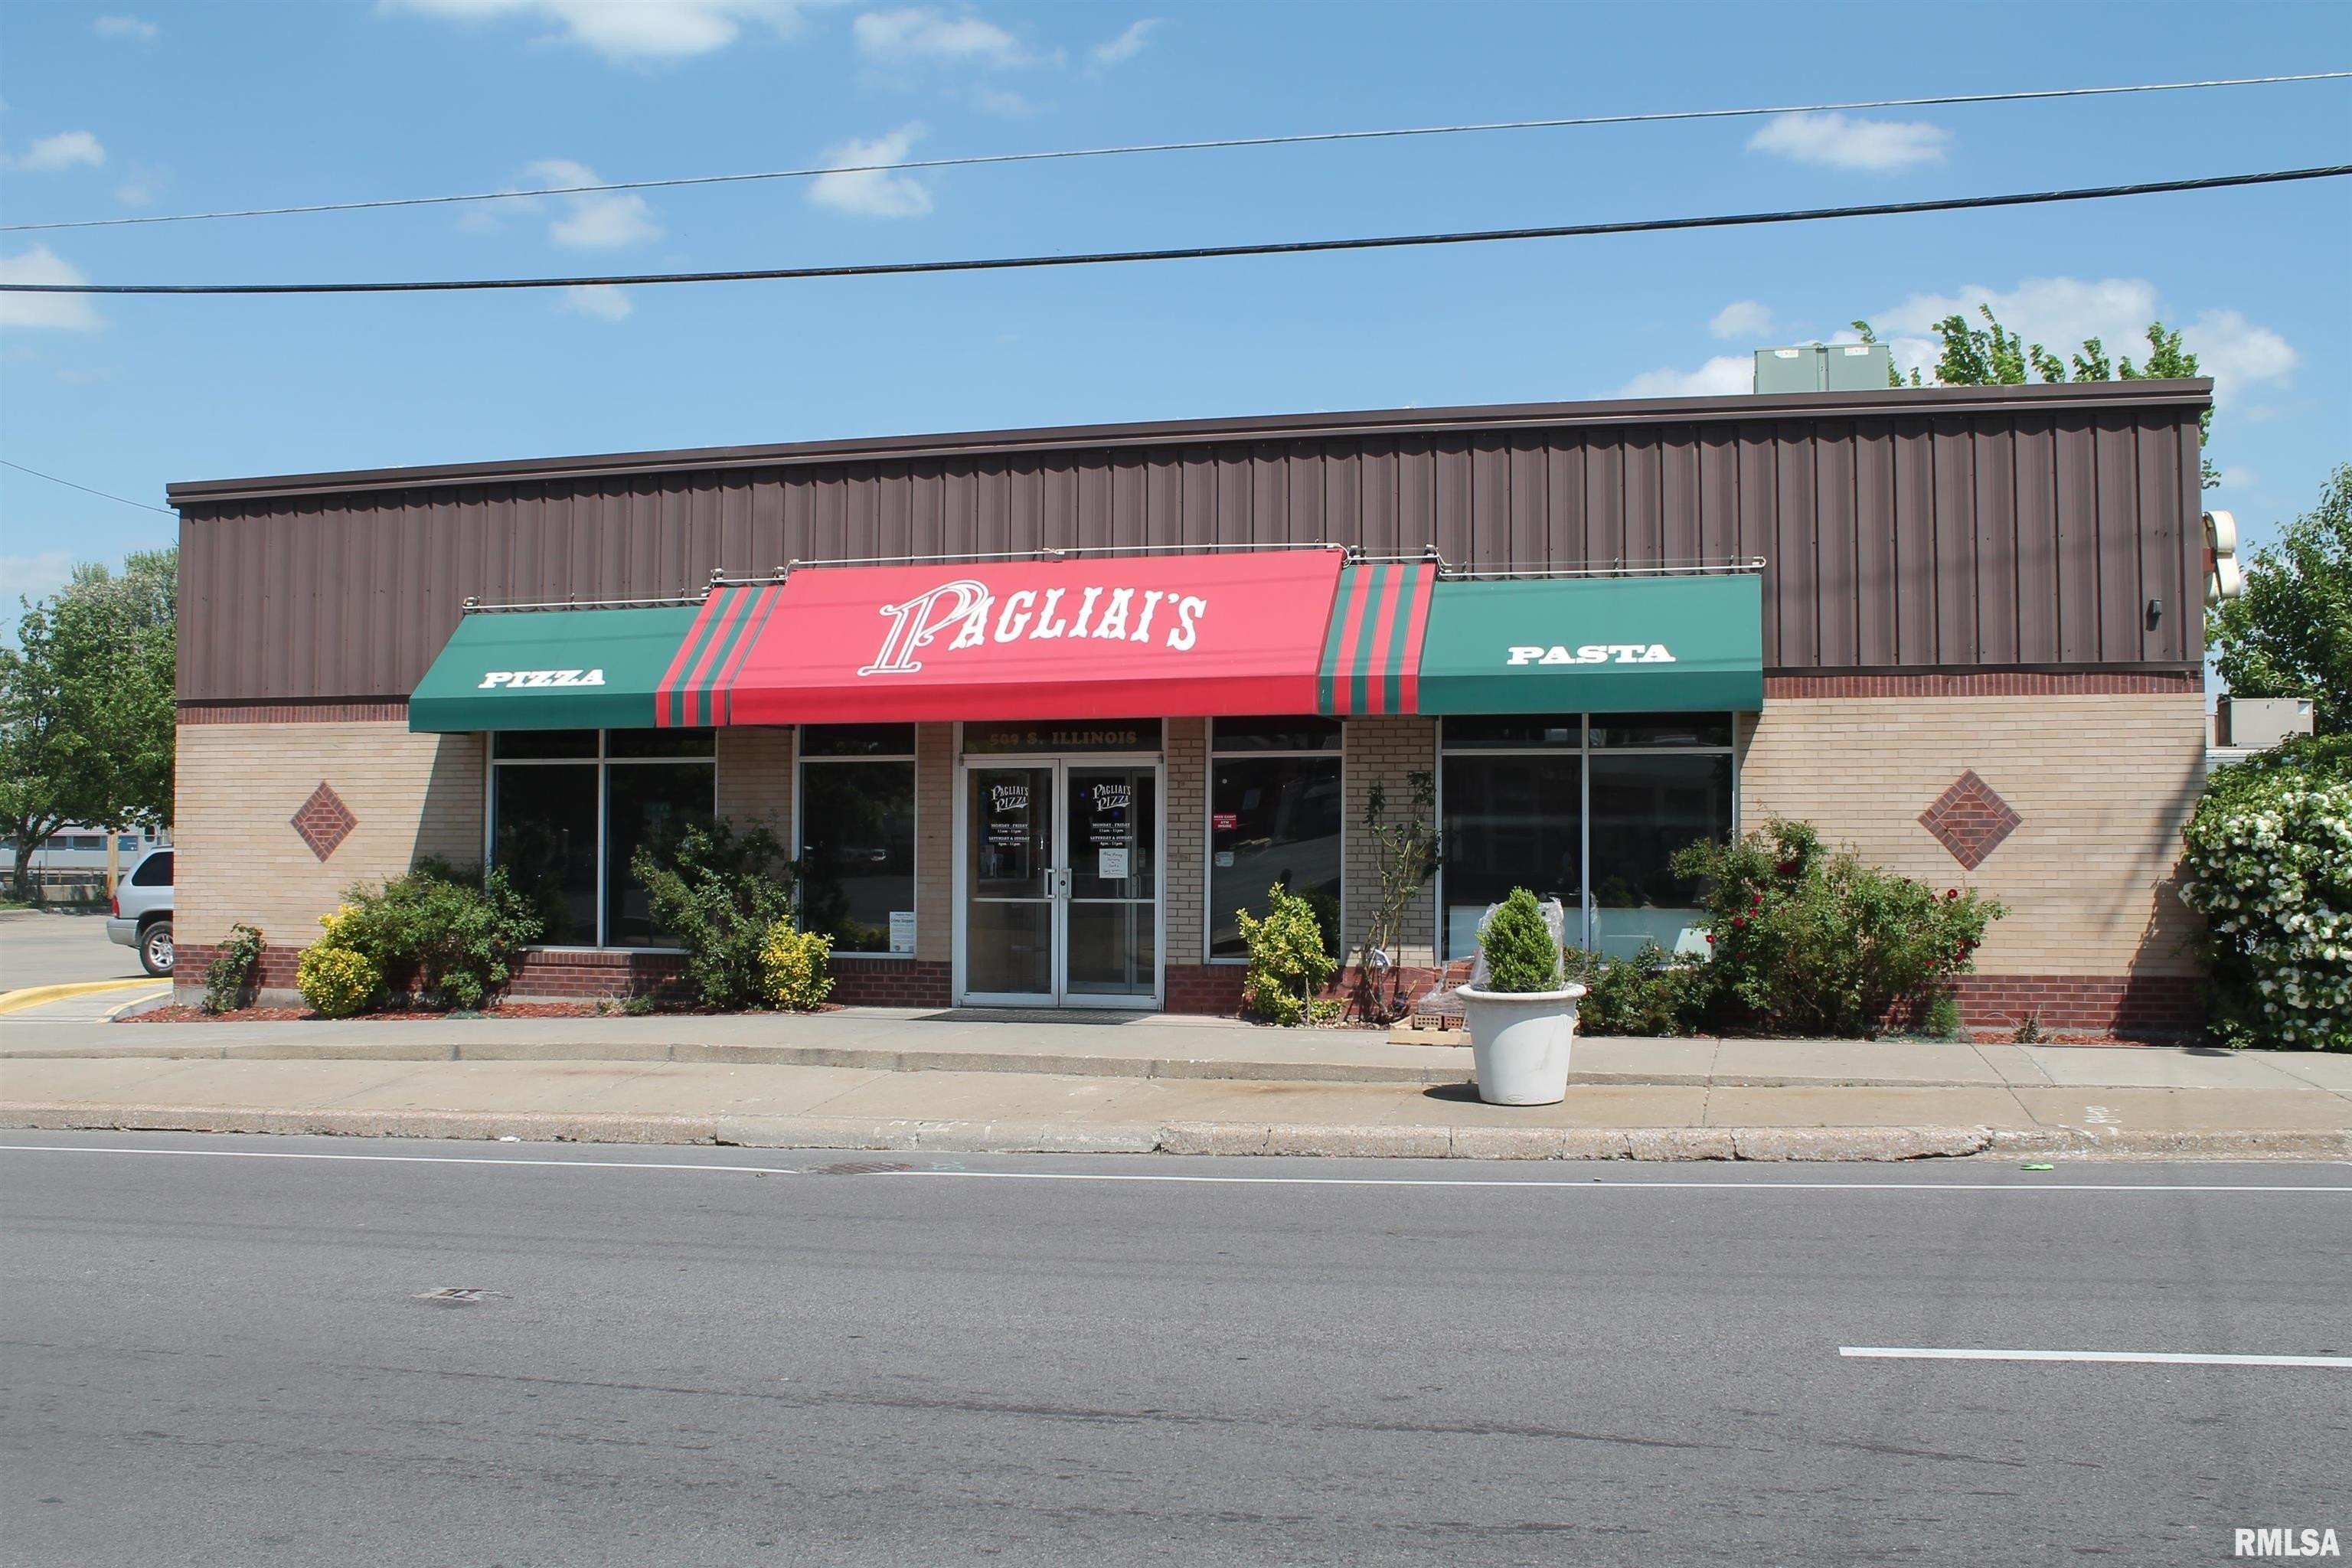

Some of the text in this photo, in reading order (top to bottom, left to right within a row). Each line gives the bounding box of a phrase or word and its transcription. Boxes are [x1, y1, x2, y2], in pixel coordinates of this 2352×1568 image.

[857, 580, 1207, 676] PAGLIAI'S
[1507, 644, 1676, 665] PASTA
[478, 668, 606, 689] PIZZA
[990, 731, 1137, 746] 509 S. ILLINOIS
[991, 786, 1028, 801] PAGLIAI'S
[1093, 784, 1131, 799] PAGLIAI'S
[995, 797, 1027, 813] PIZZA
[1096, 795, 1130, 812] PIZZA
